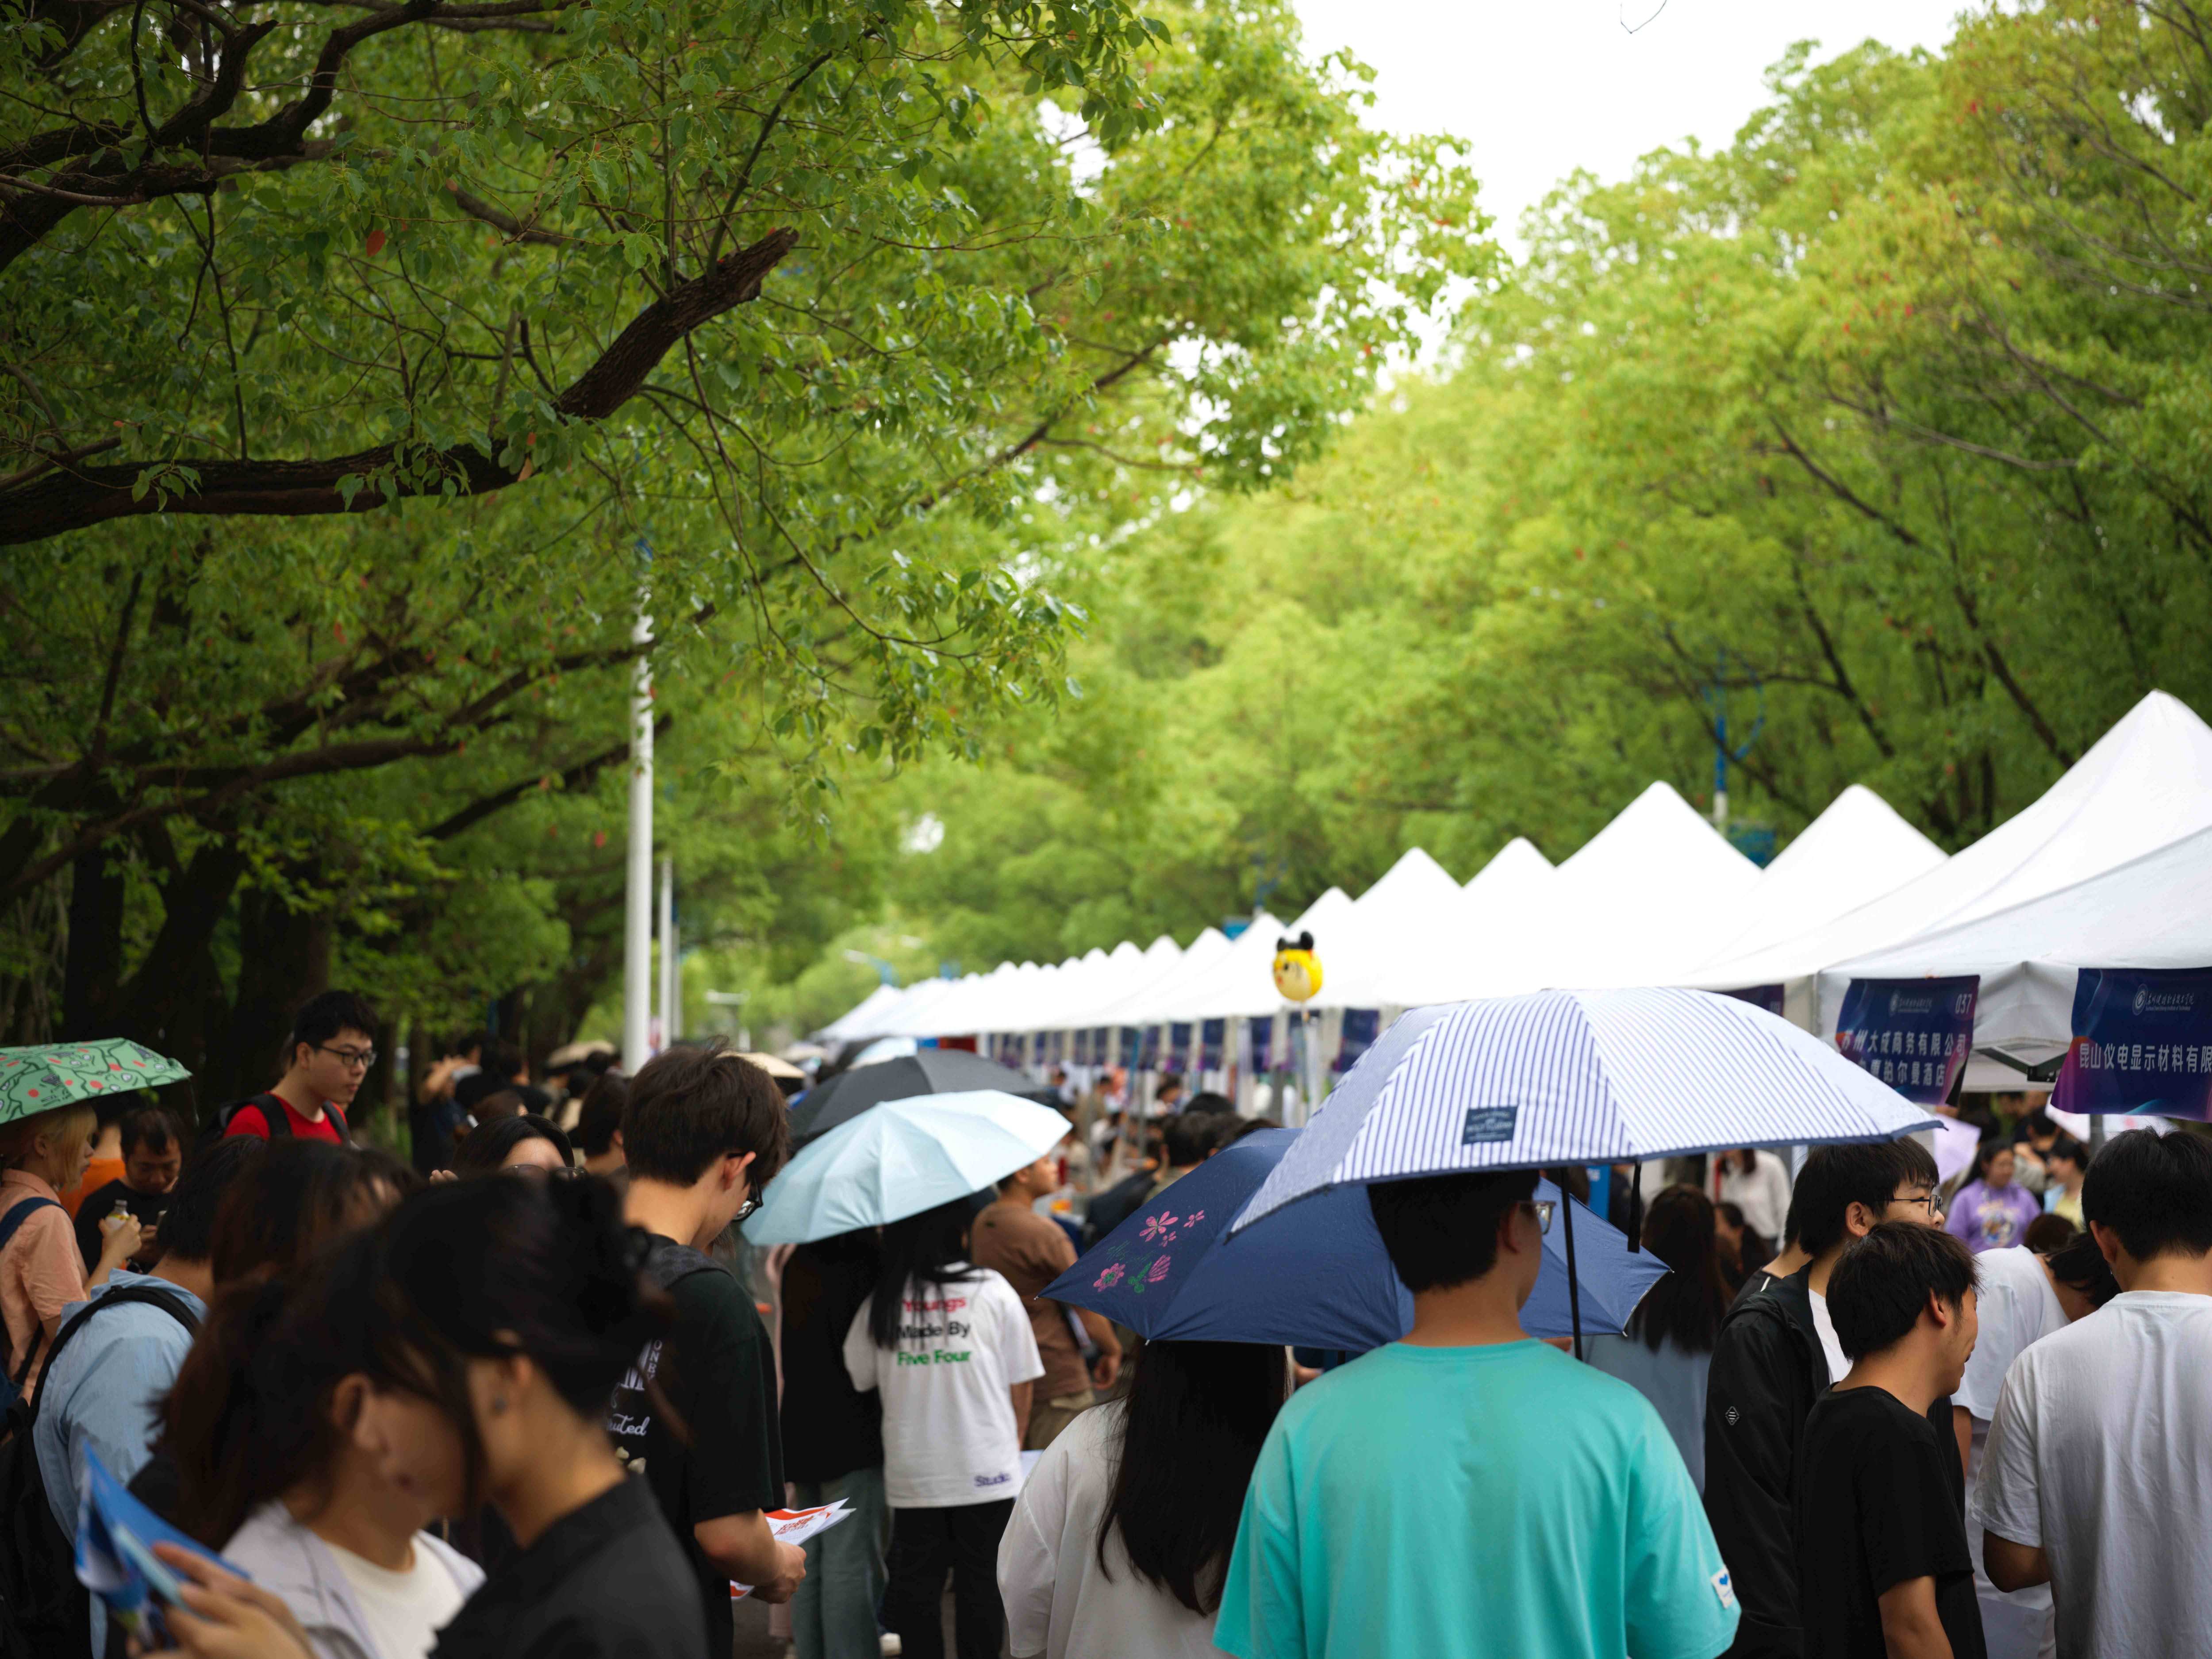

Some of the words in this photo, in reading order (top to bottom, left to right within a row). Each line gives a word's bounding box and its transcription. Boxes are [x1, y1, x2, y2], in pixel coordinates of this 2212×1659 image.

[1955, 994, 1973, 1014] 037
[2079, 1043, 2212, 1073] 昆山仪电显示材料有限
[899, 1323, 942, 1338] Made
[949, 1321, 971, 1338] By
[897, 1351, 929, 1366] Five
[934, 1349, 972, 1364] Four
